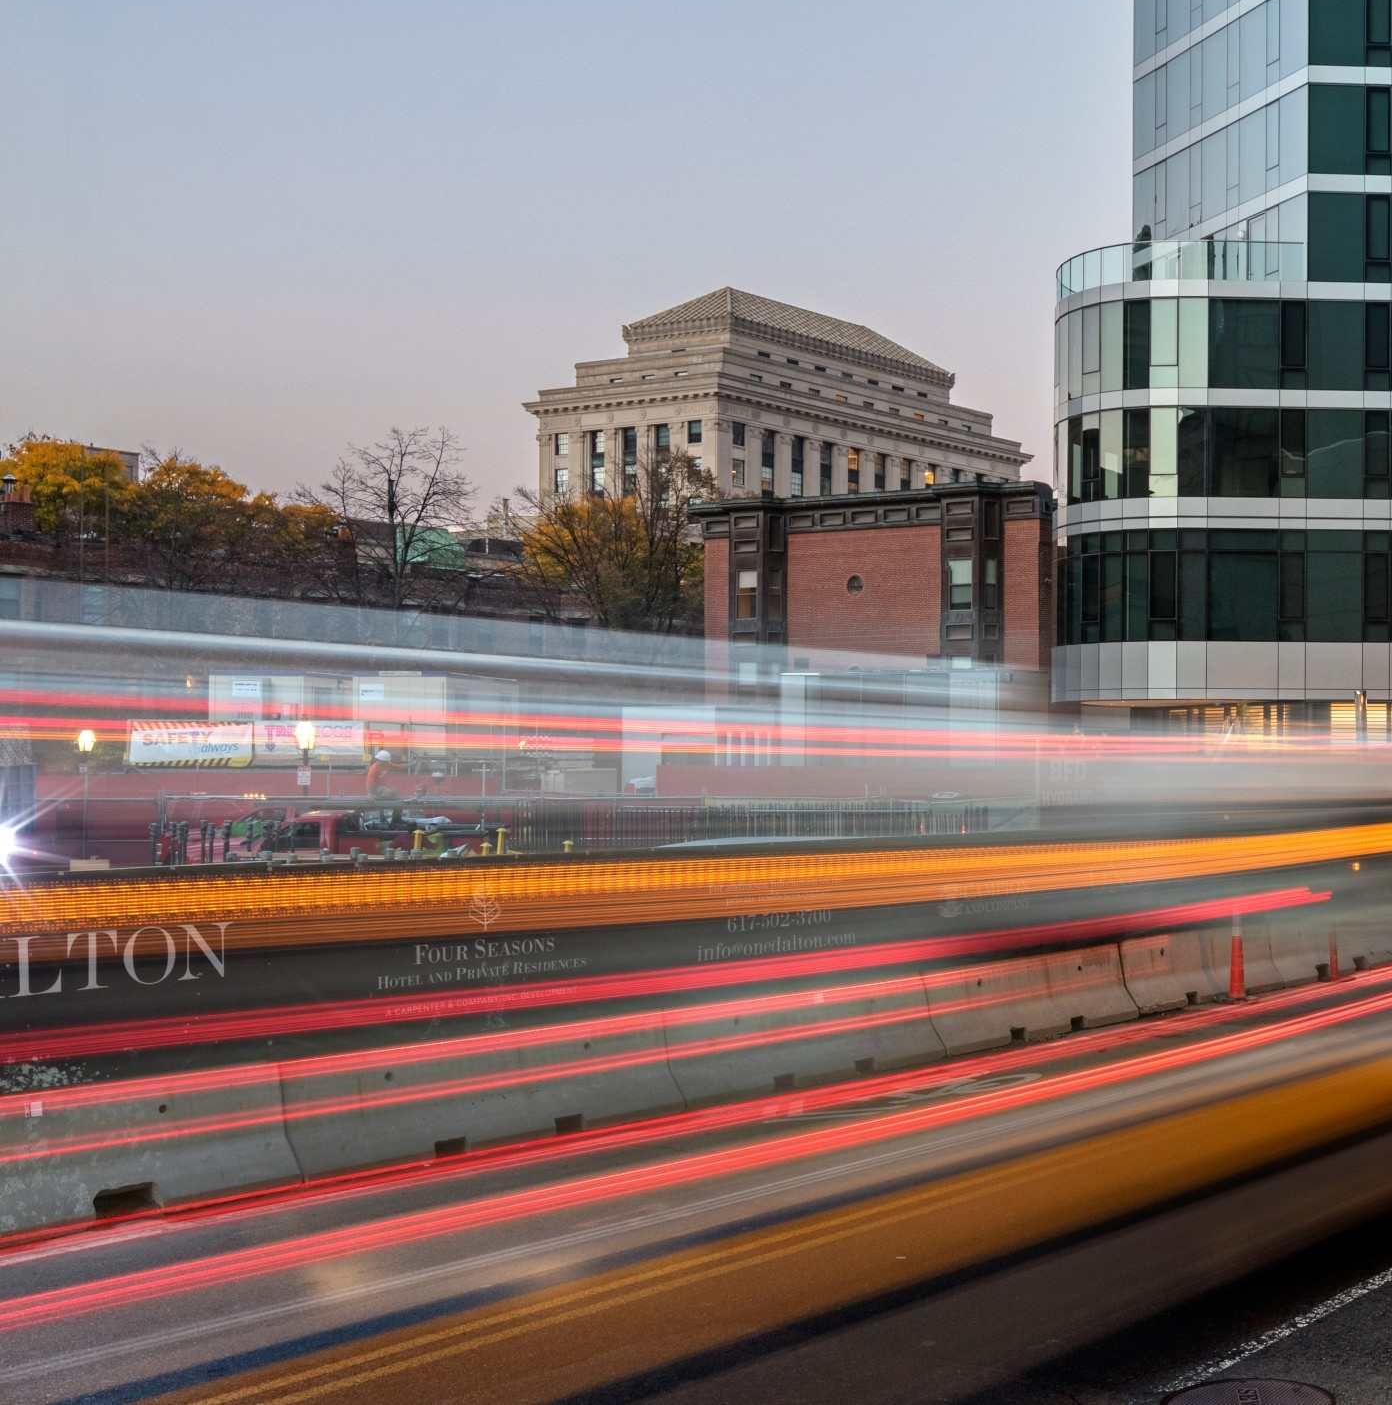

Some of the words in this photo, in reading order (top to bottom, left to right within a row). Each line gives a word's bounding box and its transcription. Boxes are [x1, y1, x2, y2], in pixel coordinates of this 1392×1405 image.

[142, 730, 212, 747] SAFETY
[200, 742, 240, 754] always
[0, 922, 233, 998] LTON
[414, 943, 469, 965] FOUR
[474, 937, 556, 959] SEASONS
[696, 931, 857, 962] info@onedalton.com
[377, 974, 423, 990] HOTEL
[428, 971, 452, 984] AND
[456, 963, 510, 981] PRIVATE
[513, 957, 588, 975] RESIDENCES
